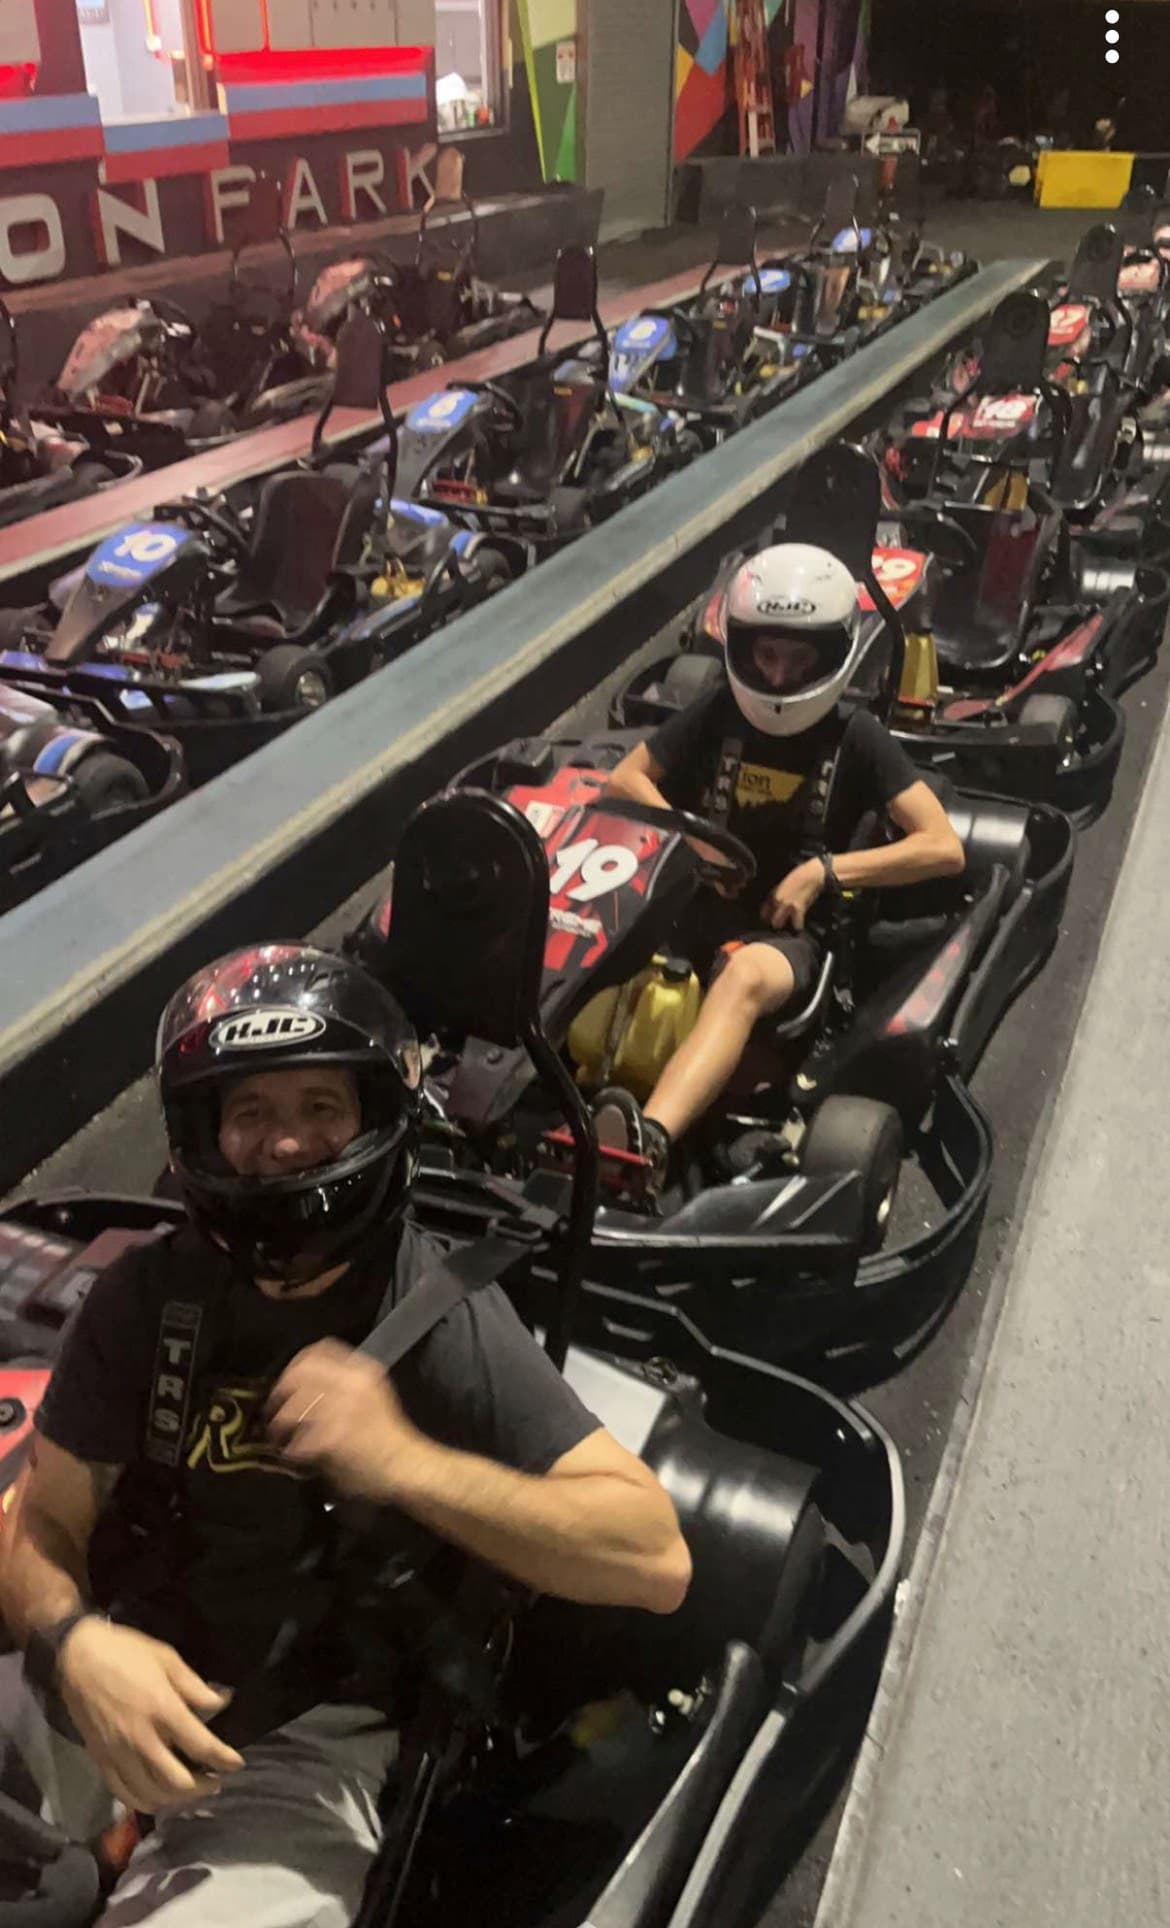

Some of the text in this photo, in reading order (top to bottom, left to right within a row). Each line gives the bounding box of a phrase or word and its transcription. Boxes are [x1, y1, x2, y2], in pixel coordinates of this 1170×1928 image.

[114, 531, 177, 561] 10
[550, 838, 639, 902] 19
[223, 1017, 309, 1042] HJC
[153, 1337, 191, 1432] TRS
